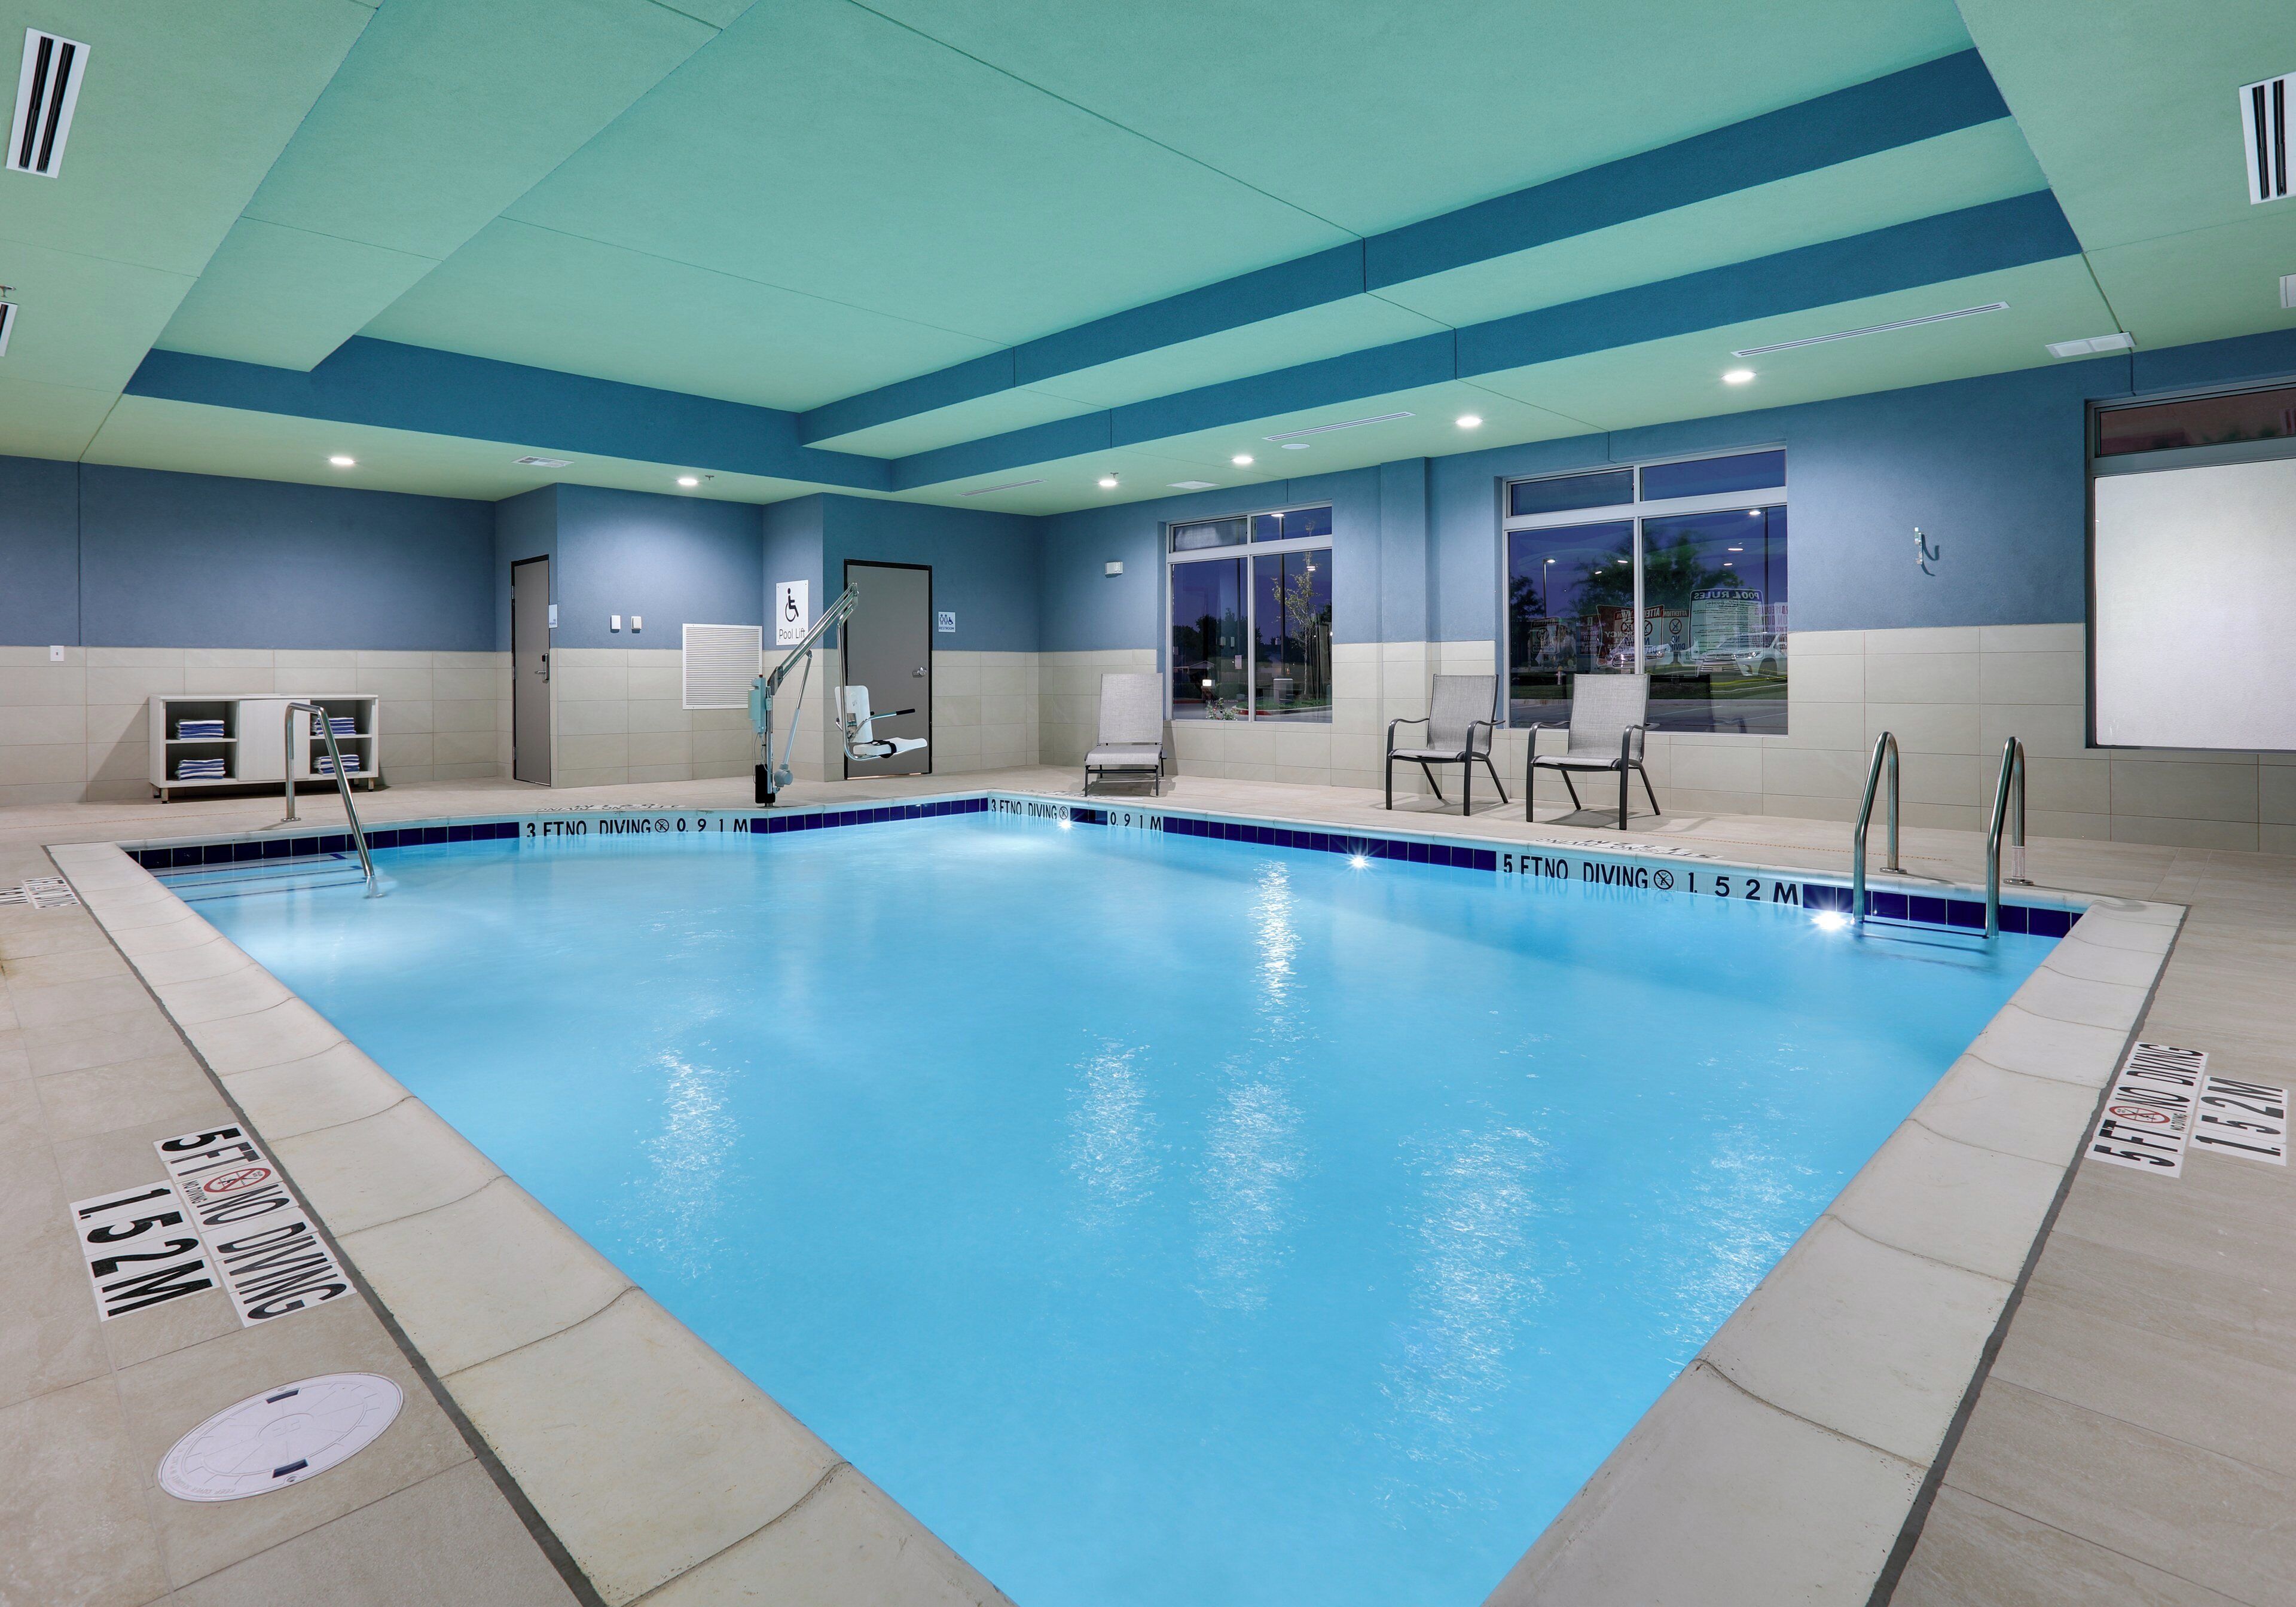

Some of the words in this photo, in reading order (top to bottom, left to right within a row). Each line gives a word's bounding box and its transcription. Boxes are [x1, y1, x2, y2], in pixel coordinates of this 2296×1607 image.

[779, 629, 793, 639] Pool
[795, 628, 805, 638] Lift
[991, 799, 996, 812] 3
[1028, 802, 1057, 819] DIVING
[526, 822, 536, 838] 3
[600, 819, 651, 835] DIVING
[1504, 854, 1512, 873] 5
[1583, 861, 1648, 889] DIVING
[2126, 1043, 2204, 1086] DIVING
[2115, 1086, 2191, 1113] NO
[161, 1128, 242, 1152] 5
[2098, 1119, 2181, 1152] FT
[170, 1141, 261, 1177] FT
[2093, 1144, 2176, 1167] 5
[182, 1180, 199, 1189] NO
[185, 1187, 207, 1203] DIVING
[197, 1184, 289, 1226] NO
[216, 1221, 347, 1320] DIVING
